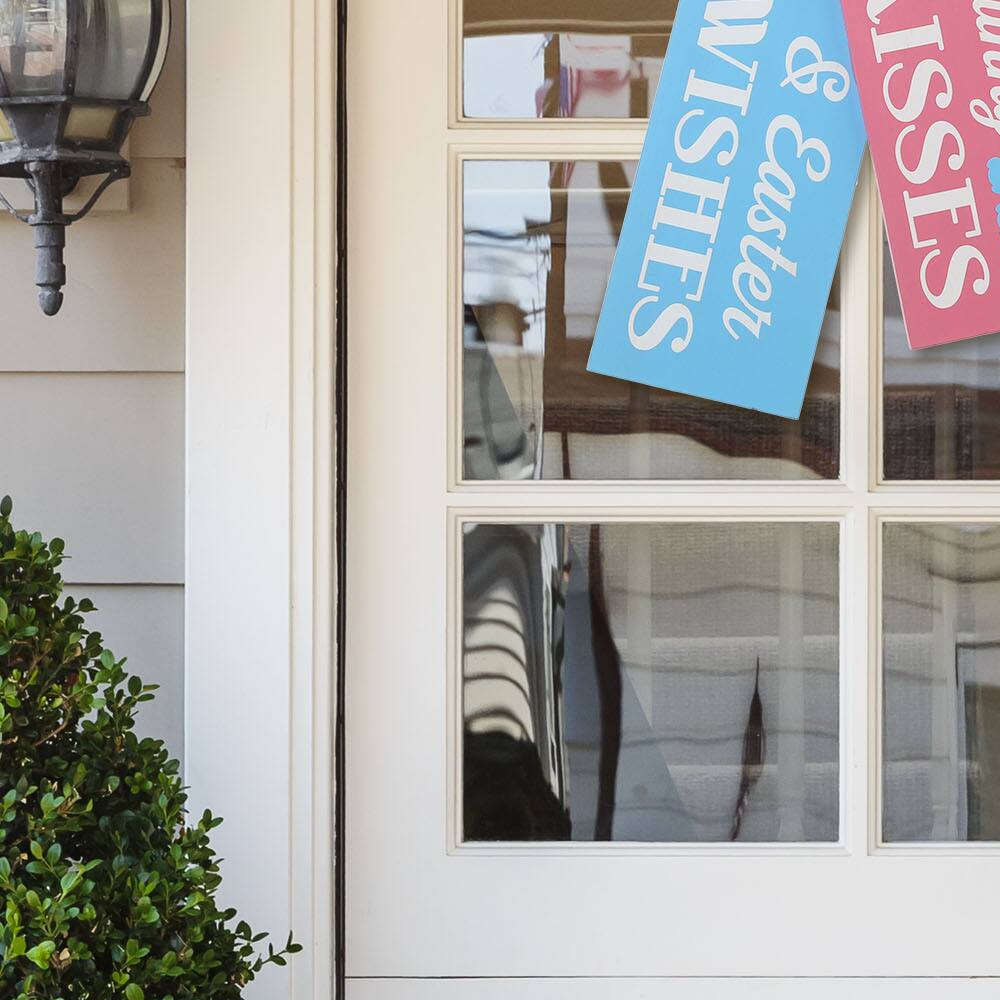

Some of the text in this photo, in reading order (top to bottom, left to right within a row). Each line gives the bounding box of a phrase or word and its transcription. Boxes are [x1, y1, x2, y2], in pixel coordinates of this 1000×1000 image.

[628, 0, 774, 353] WISHES
[722, 36, 850, 340] & Easter
[866, 0, 990, 309] ISSES
